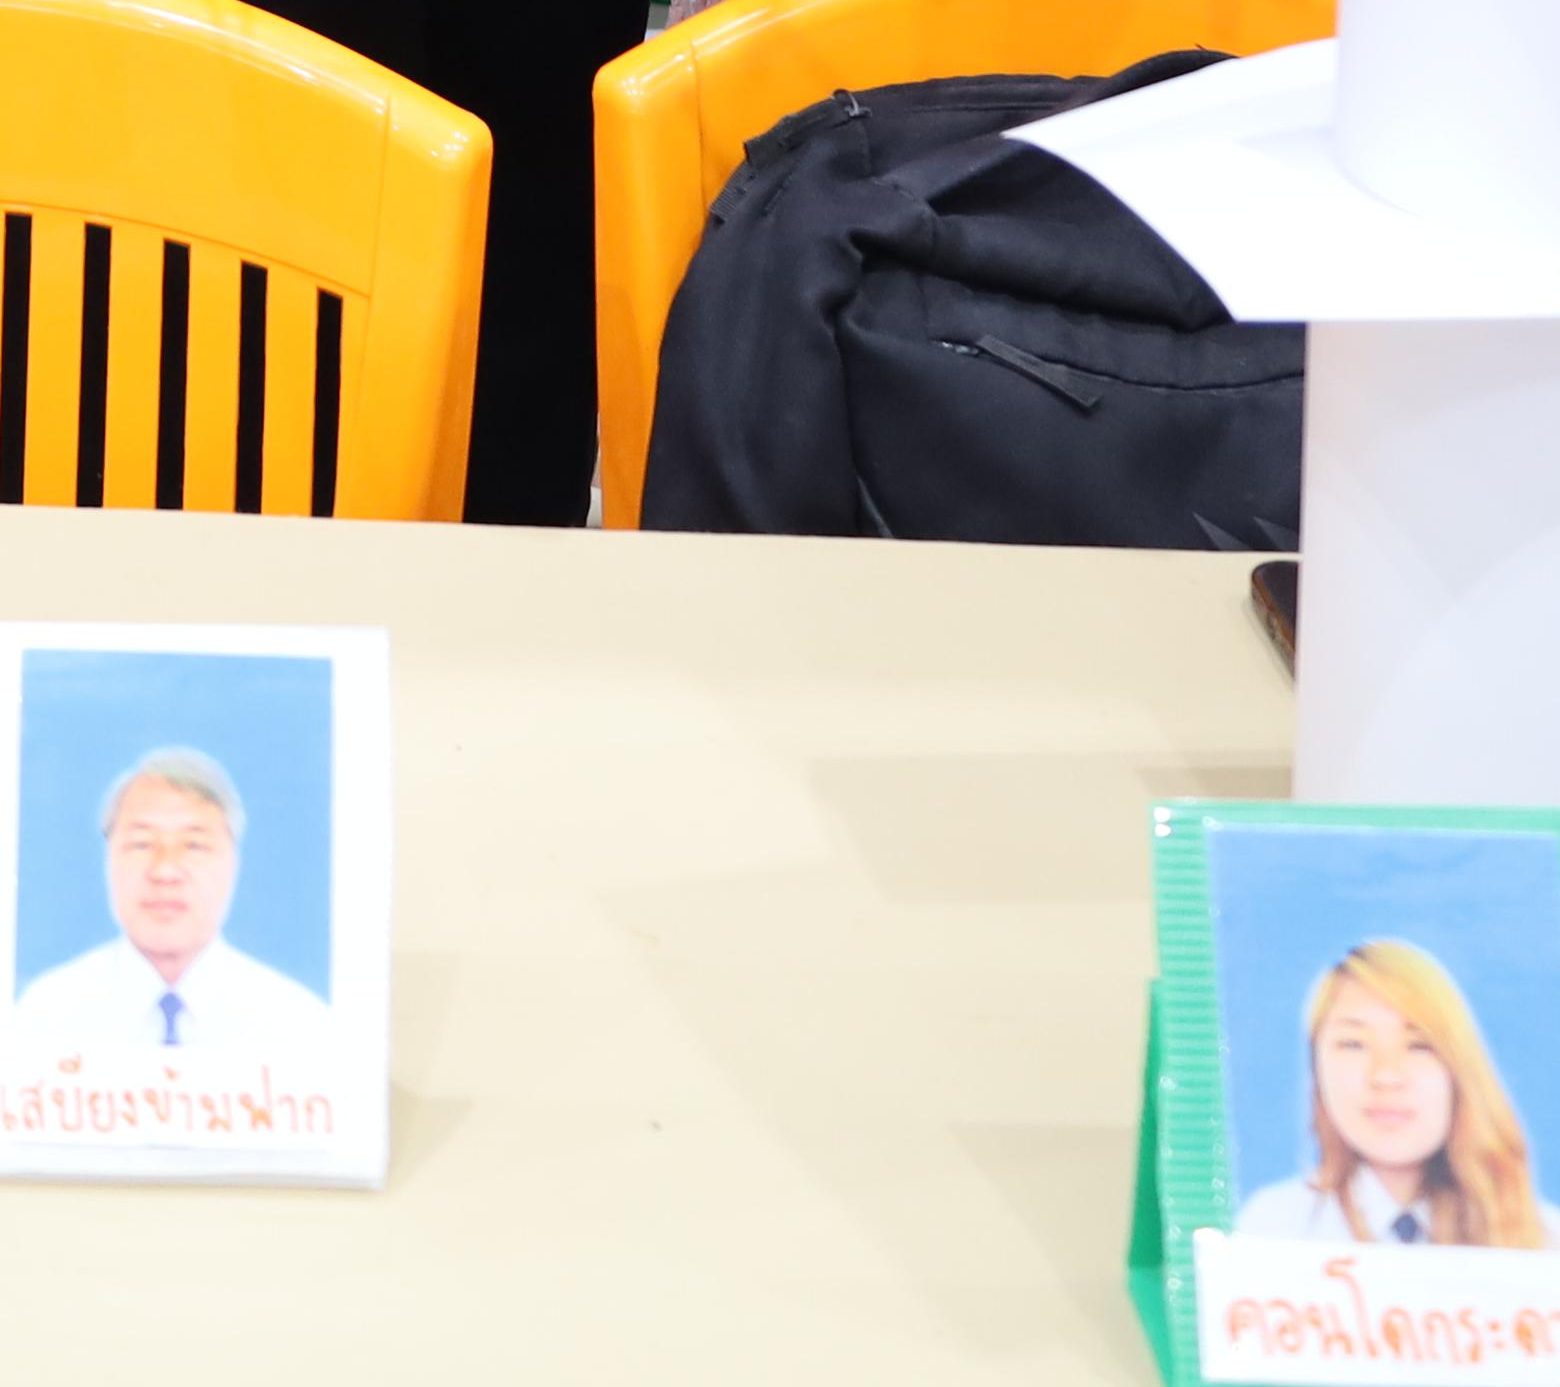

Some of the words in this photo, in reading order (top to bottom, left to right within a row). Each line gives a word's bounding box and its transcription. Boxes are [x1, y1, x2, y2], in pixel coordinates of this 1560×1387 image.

[0, 1053, 335, 1136] เสบียงข้ามฟาก
